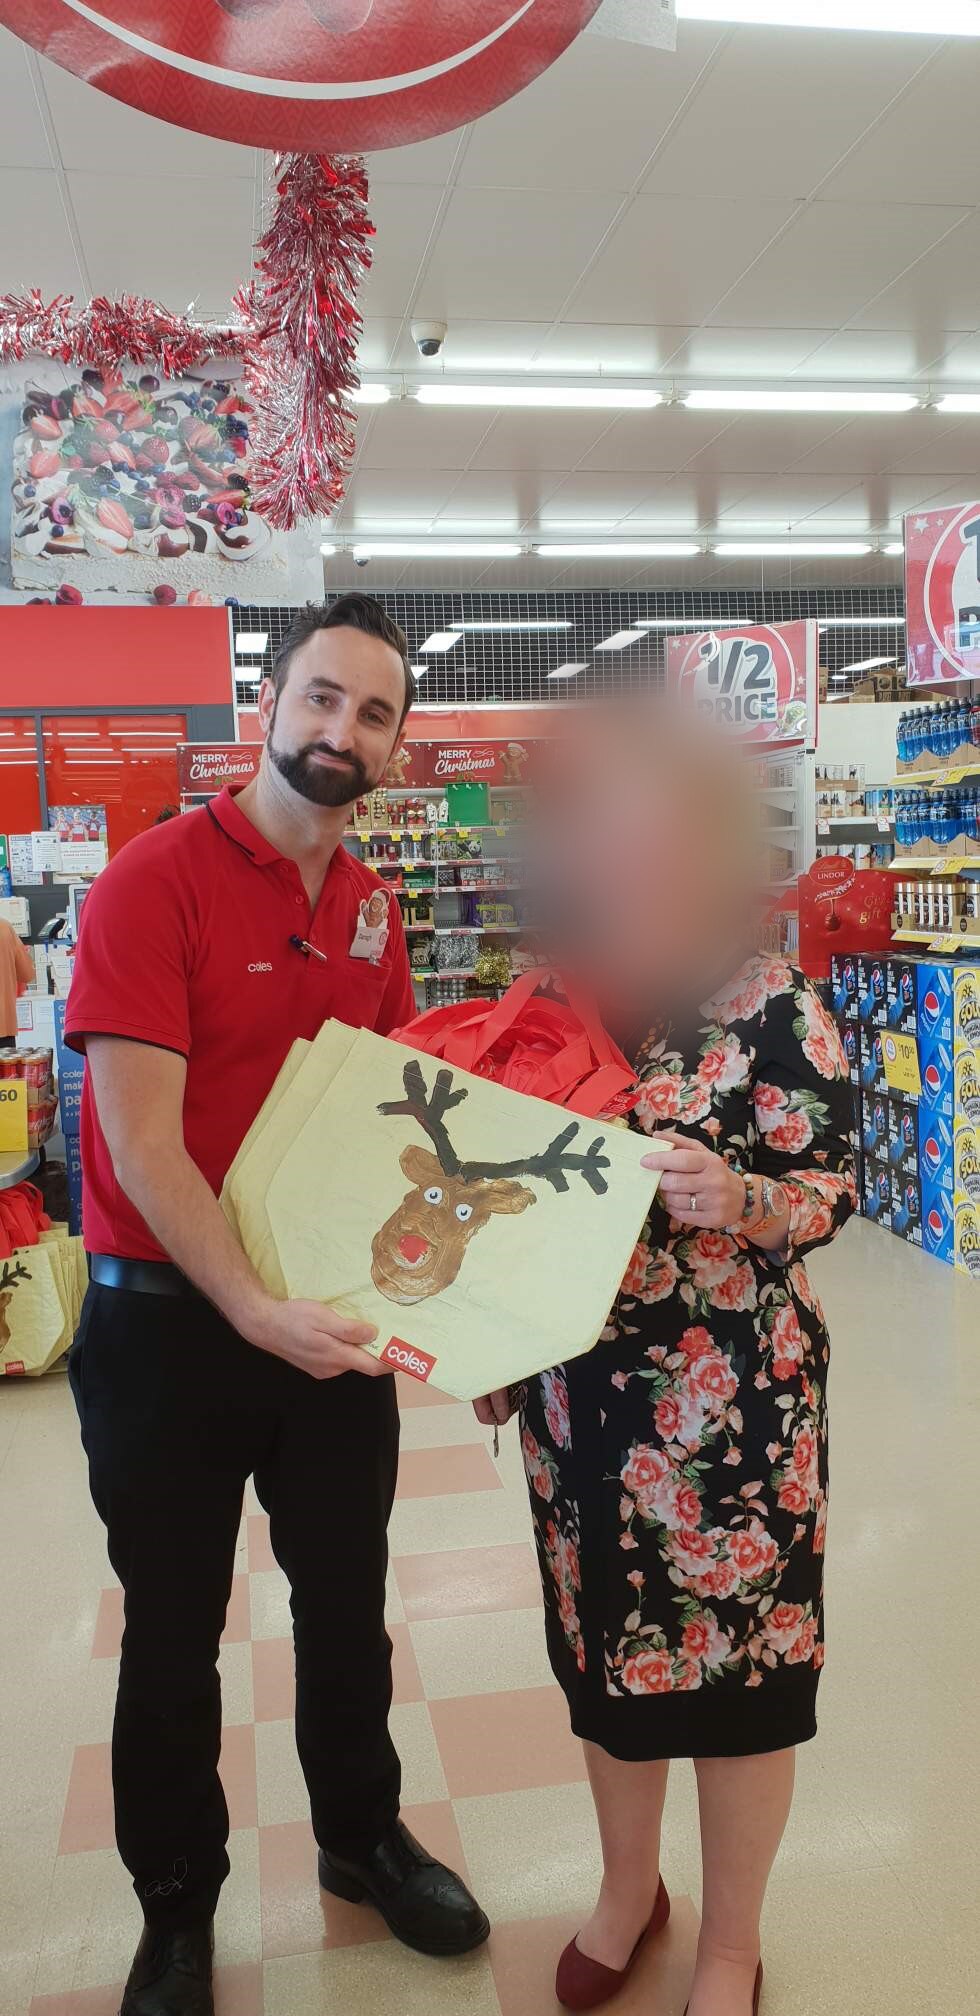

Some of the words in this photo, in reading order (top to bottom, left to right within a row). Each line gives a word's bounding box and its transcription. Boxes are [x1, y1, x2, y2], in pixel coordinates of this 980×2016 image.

[697, 691, 776, 722] PRICE
[192, 754, 227, 763] MERRY
[438, 750, 472, 758] MERRY
[189, 761, 255, 780] Christmas
[434, 757, 495, 775] Christmas
[817, 871, 845, 879] LINDOR
[247, 960, 273, 973] coles
[960, 1003, 980, 1026] SOL
[961, 1079, 980, 1103] SOL
[960, 1157, 980, 1180] SOL
[961, 1232, 980, 1254] SOL
[387, 1345, 428, 1375] coles
